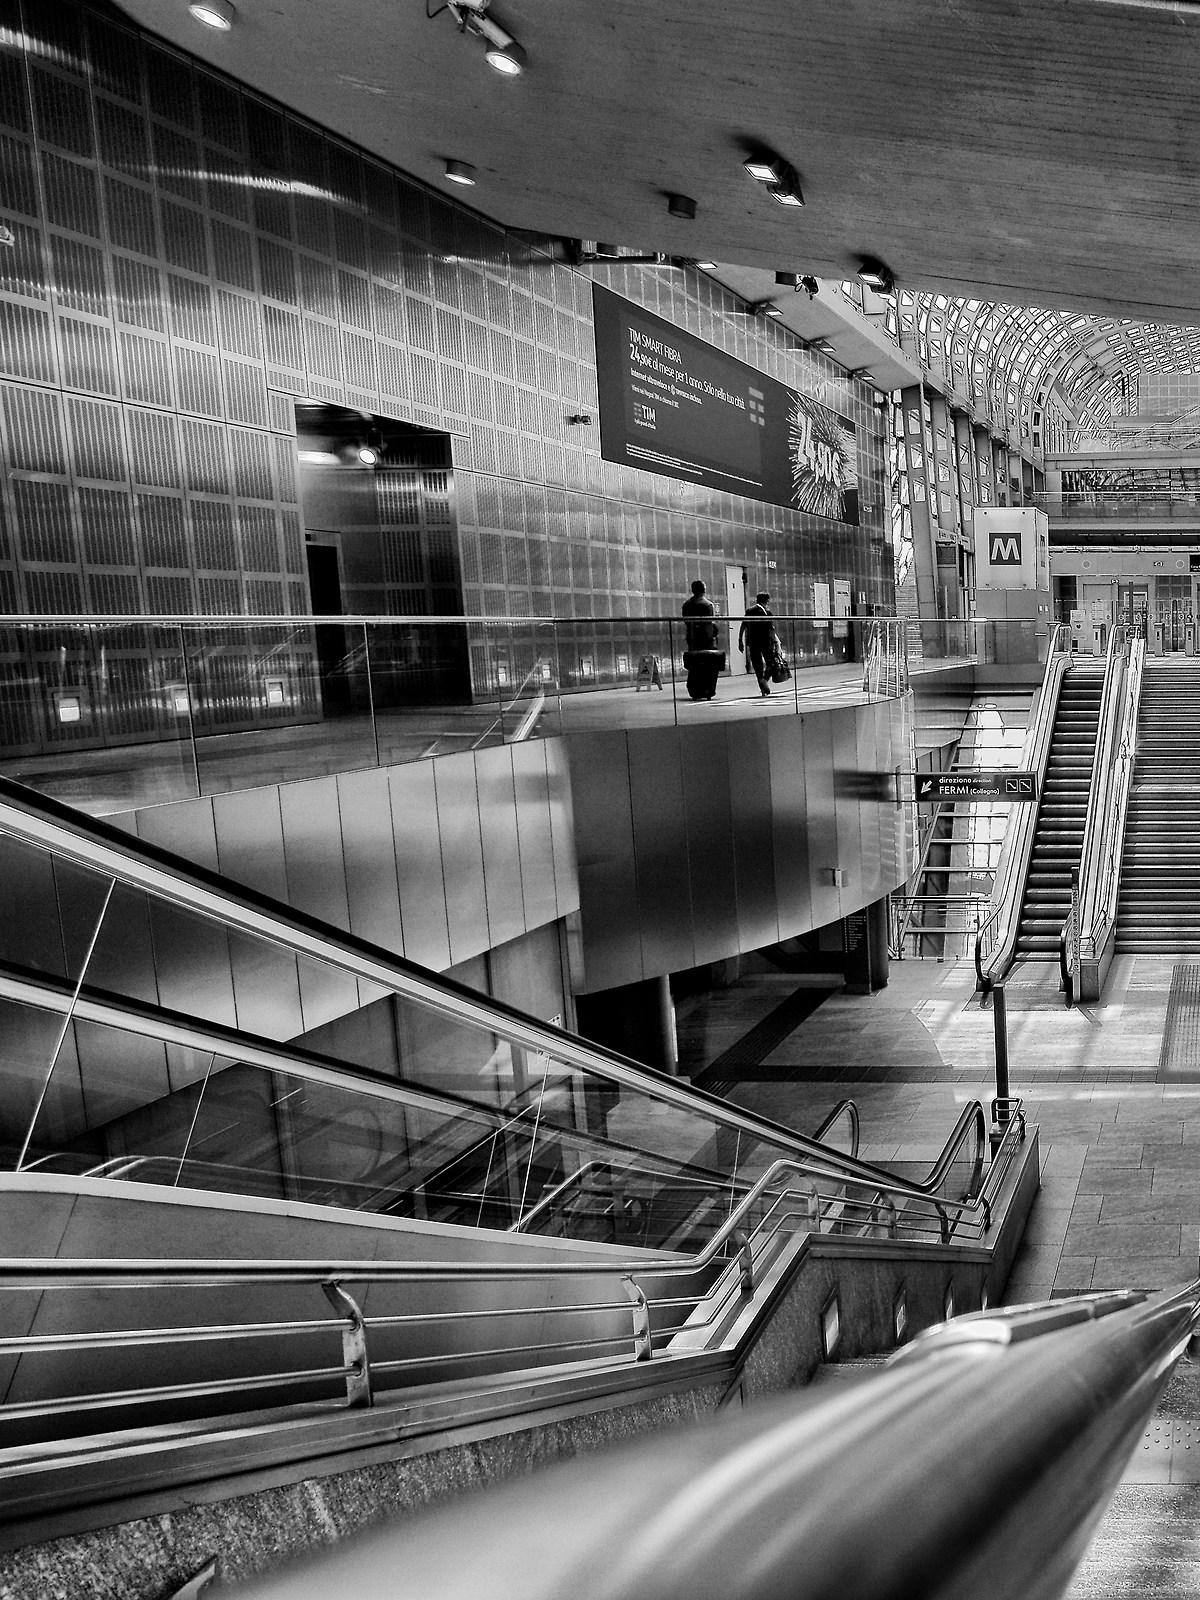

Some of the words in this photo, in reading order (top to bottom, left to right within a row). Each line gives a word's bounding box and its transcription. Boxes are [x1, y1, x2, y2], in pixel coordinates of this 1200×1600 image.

[628, 327, 641, 345] TIM
[642, 334, 663, 356] SMART
[664, 345, 682, 365] FIBRA
[659, 362, 675, 378] mese
[675, 370, 684, 383] per
[704, 381, 715, 396] Solo
[715, 388, 726, 402] nella
[642, 405, 656, 422] TIM
[991, 538, 1020, 560] M
[939, 786, 969, 795] FERMI
[970, 788, 1000, 796] (Collegno)
